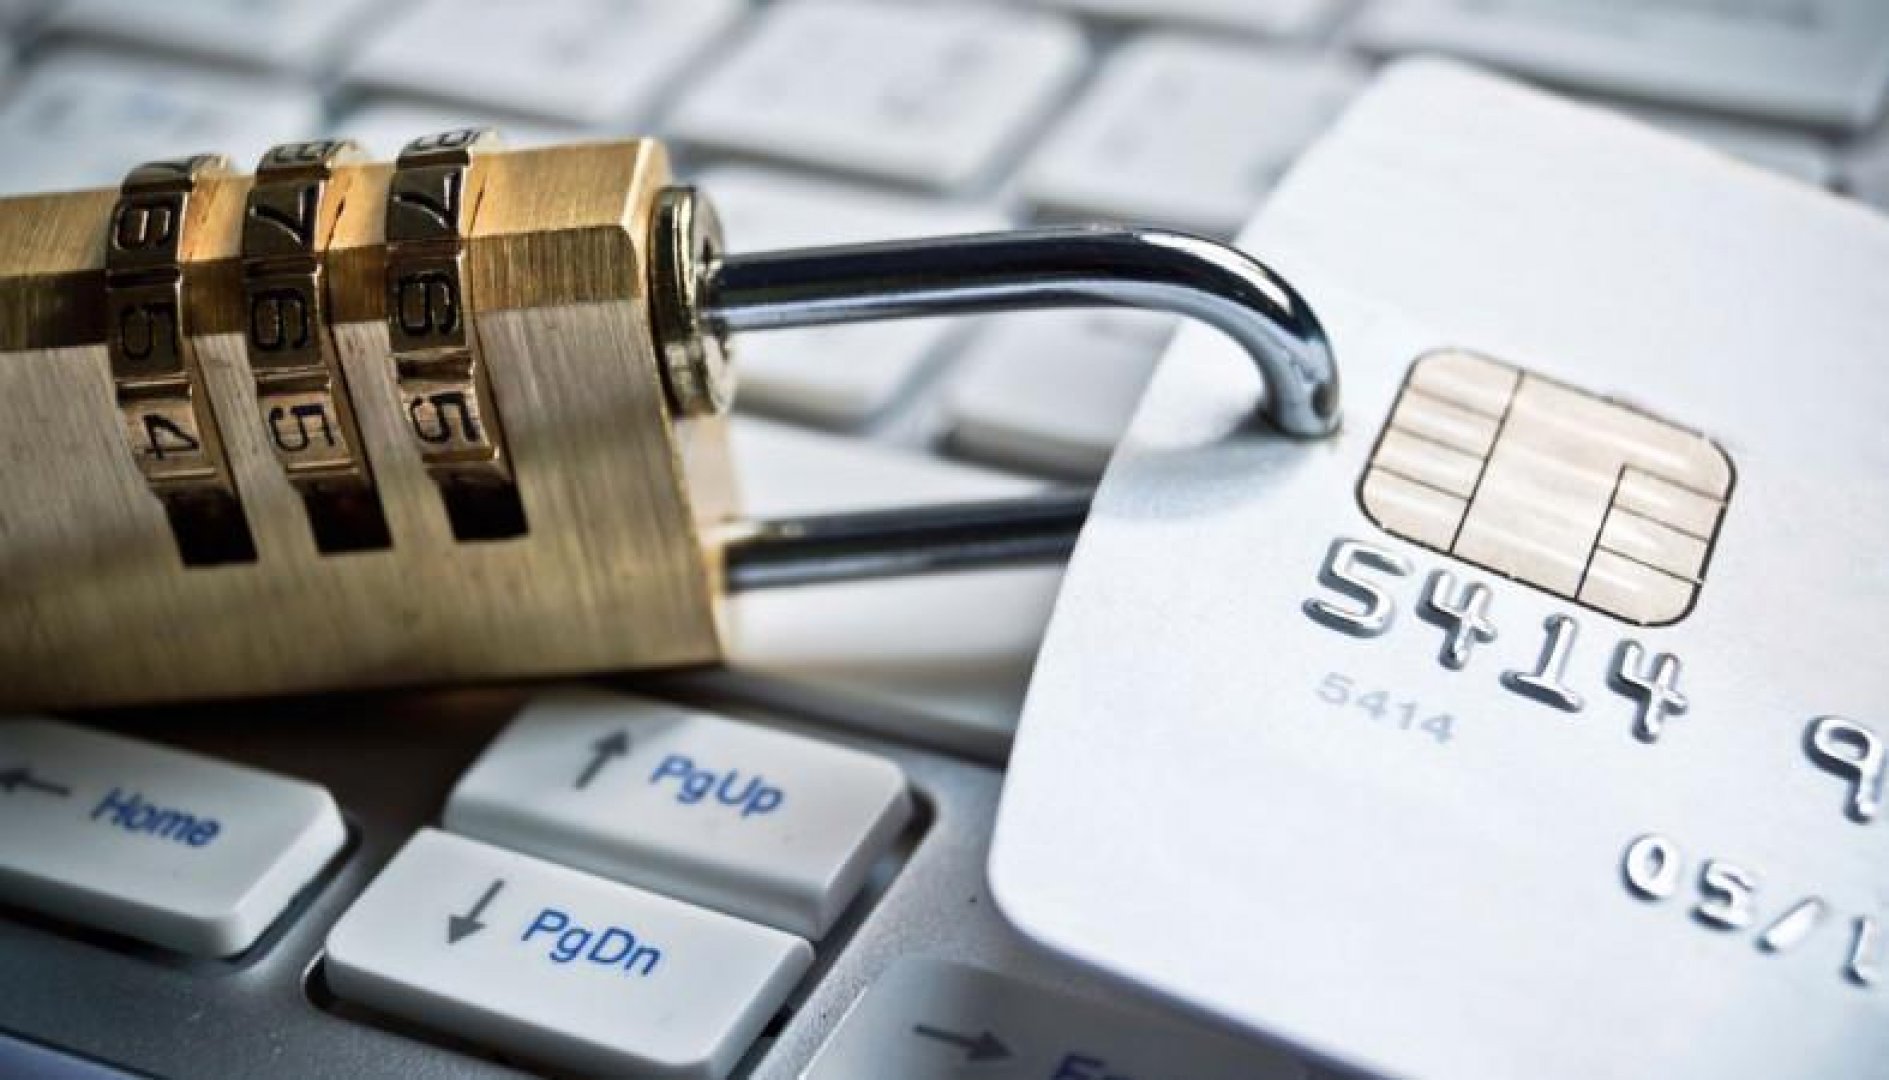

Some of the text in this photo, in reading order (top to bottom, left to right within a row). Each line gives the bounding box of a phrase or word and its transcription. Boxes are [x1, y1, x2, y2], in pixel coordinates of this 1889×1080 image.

[251, 183, 316, 247] 7
[394, 168, 460, 230] 7
[252, 287, 309, 351] 6
[399, 273, 457, 336] 6
[142, 413, 200, 461] 4
[268, 404, 336, 452] 5
[410, 391, 482, 443] 5
[1302, 535, 1690, 744] 5414
[1314, 671, 1458, 744] 5414
[88, 786, 220, 846] Home
[648, 753, 784, 820] PgUp
[520, 908, 662, 977] PgDn
